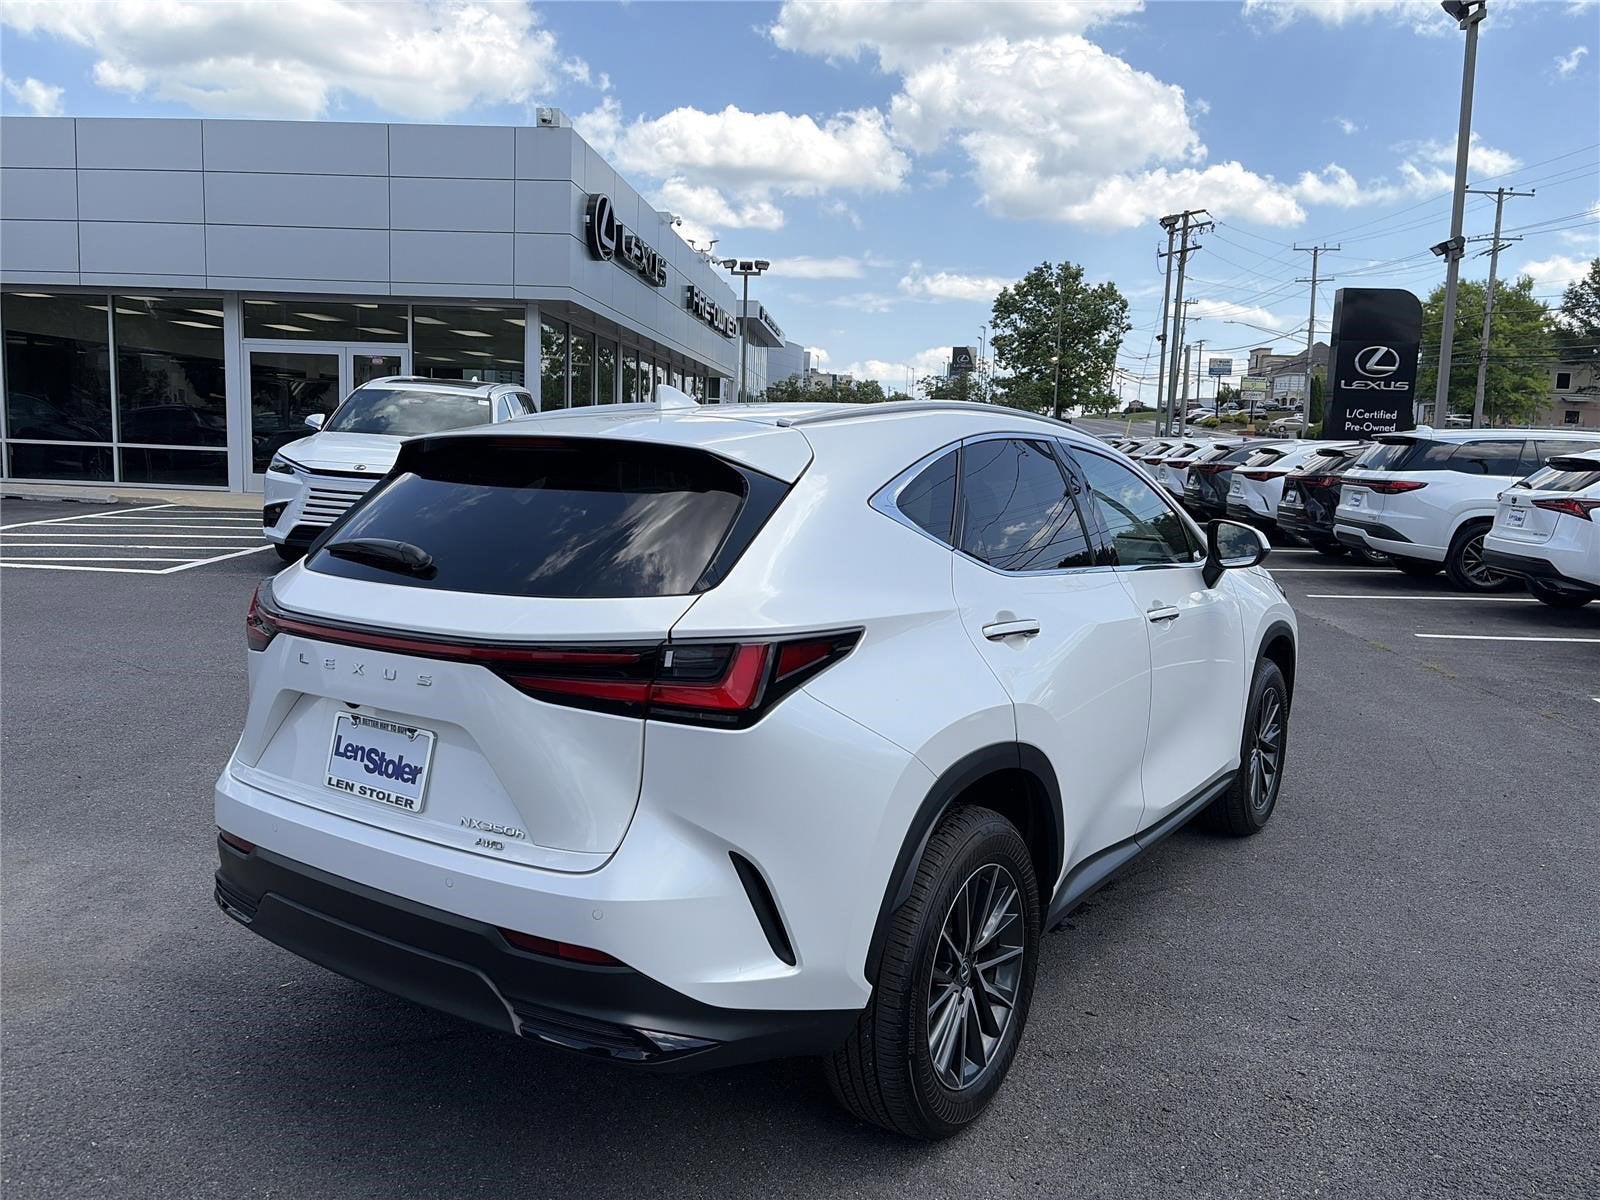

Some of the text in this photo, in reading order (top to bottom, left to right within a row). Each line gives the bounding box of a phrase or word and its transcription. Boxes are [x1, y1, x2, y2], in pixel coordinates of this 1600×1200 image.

[616, 223, 667, 287] LEXUS
[687, 286, 737, 338] PRE-OWNED
[1340, 380, 1409, 391] LEXUS
[1345, 408, 1398, 420] L/Certified
[1344, 421, 1397, 432] Pre-Owned
[299, 653, 432, 687] LEXUS
[327, 776, 414, 809] LEN STOLER
[475, 838, 504, 851] AWD
